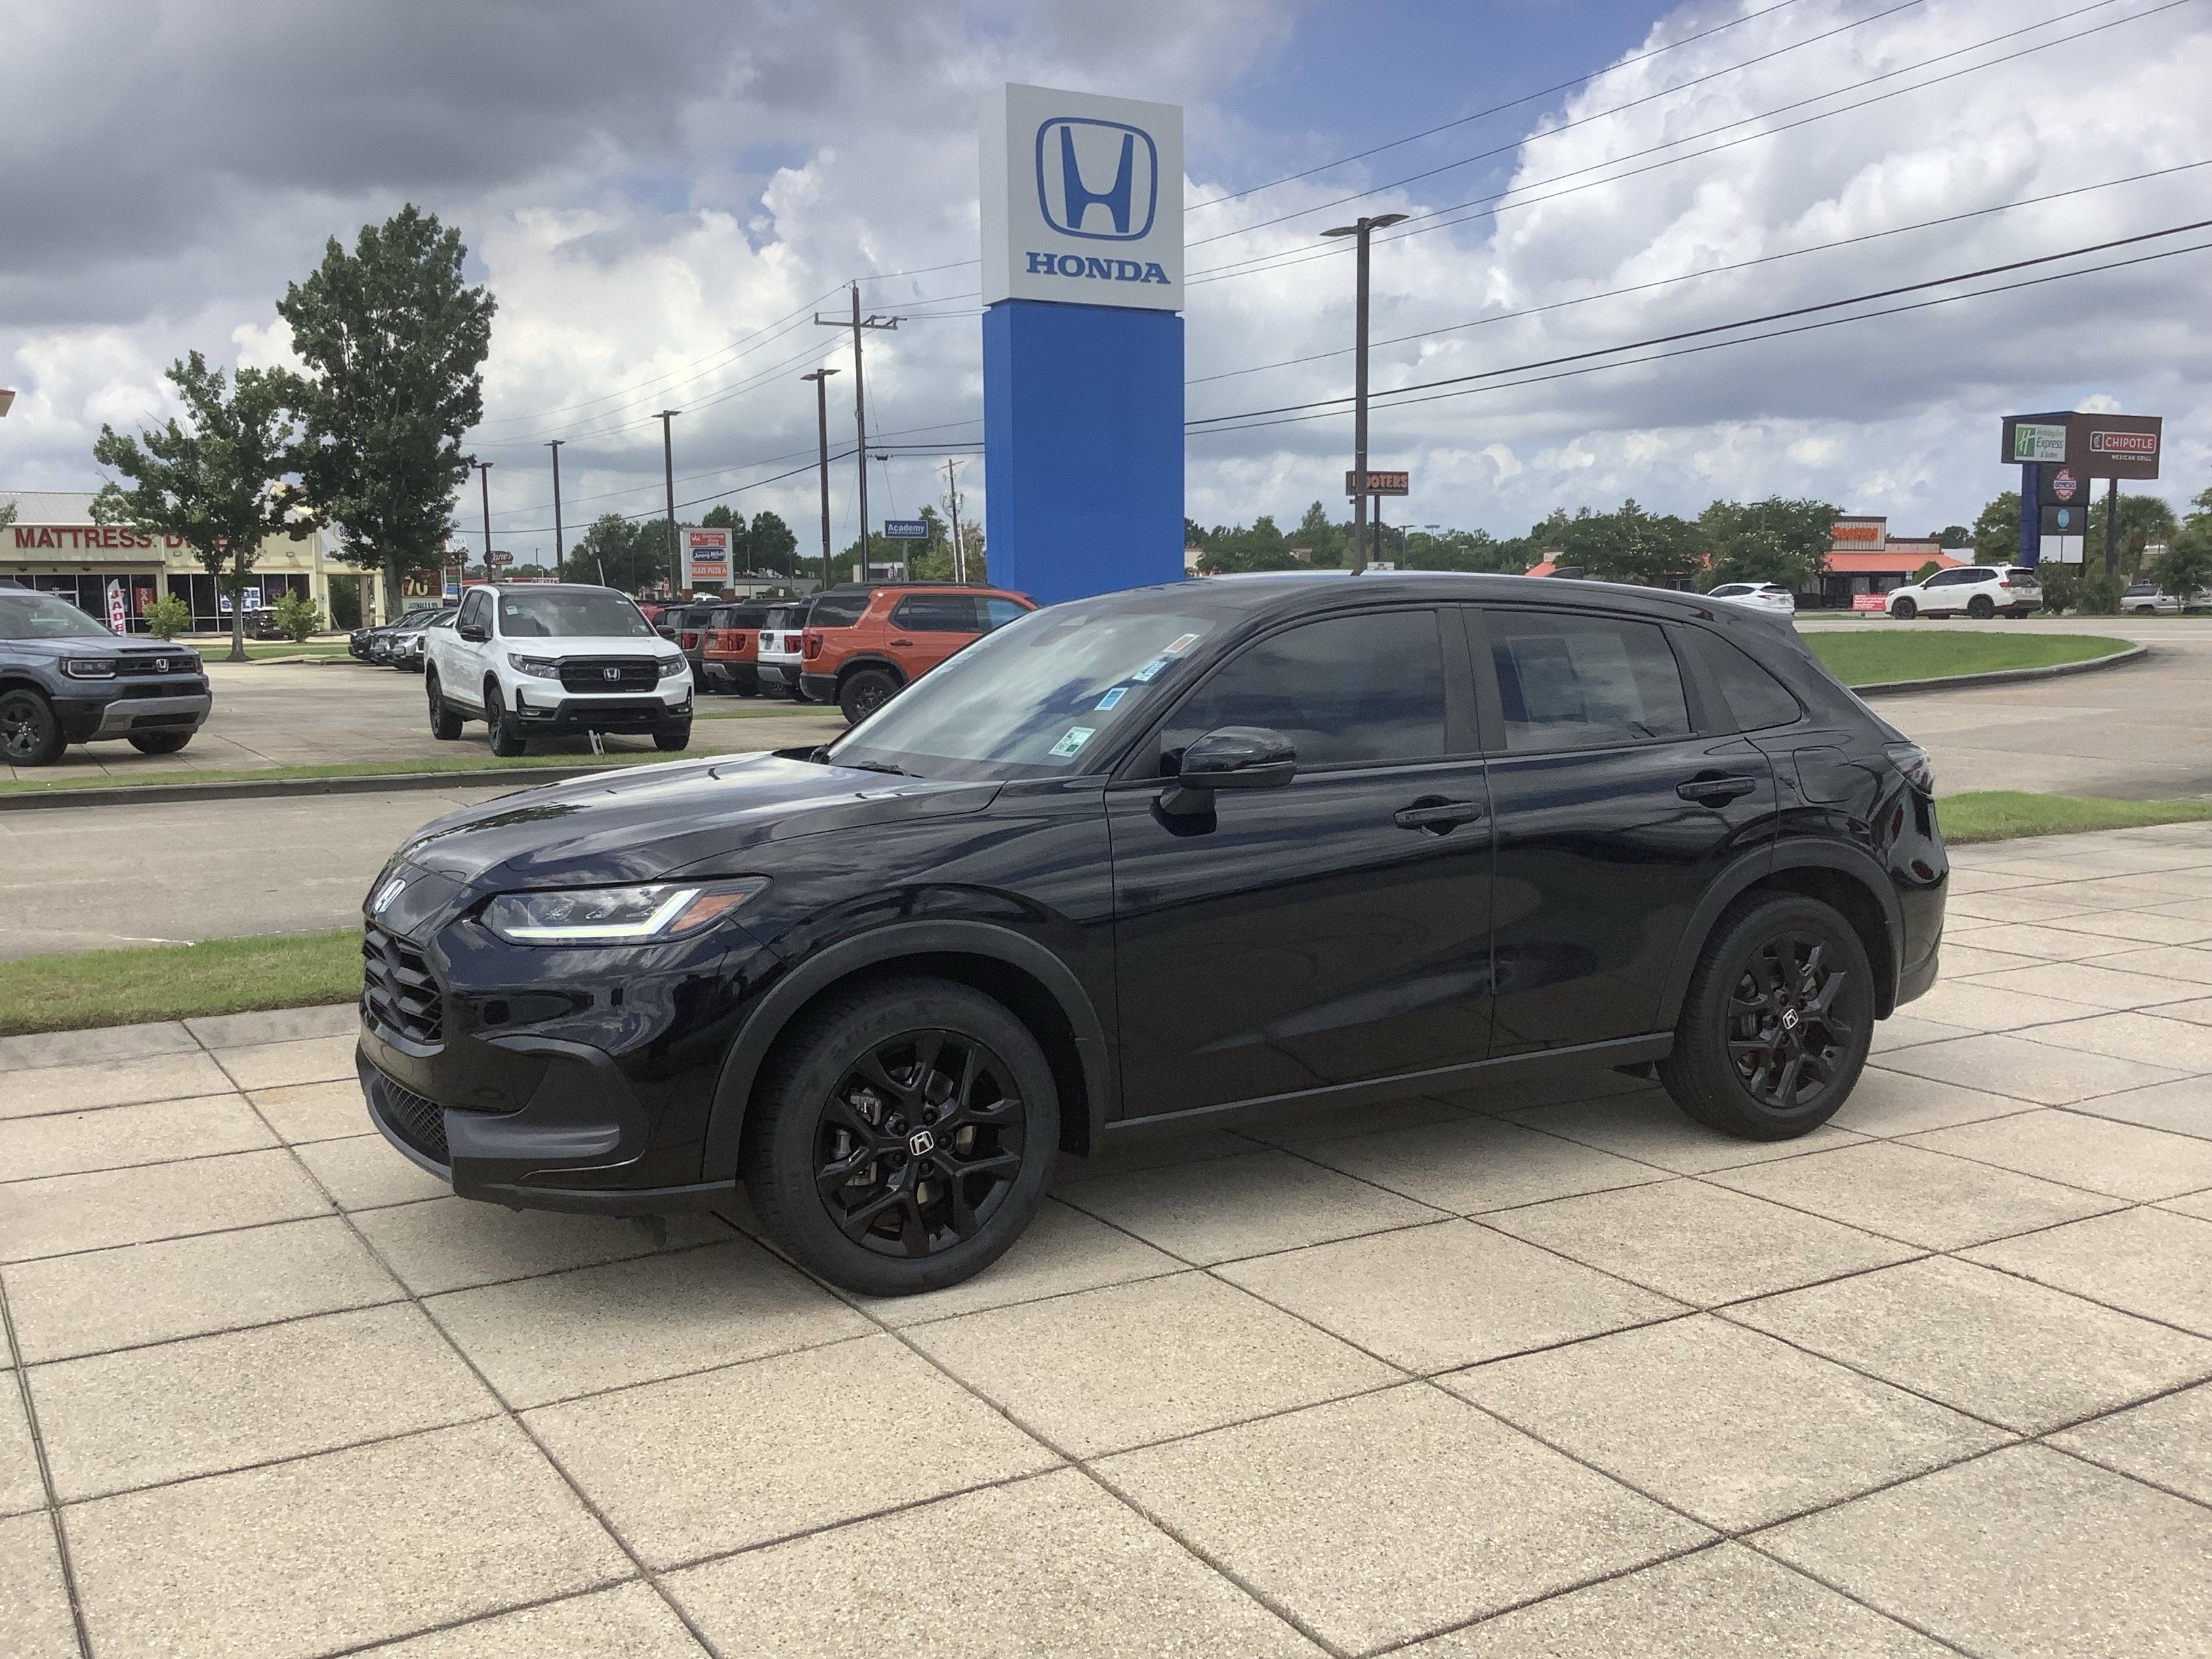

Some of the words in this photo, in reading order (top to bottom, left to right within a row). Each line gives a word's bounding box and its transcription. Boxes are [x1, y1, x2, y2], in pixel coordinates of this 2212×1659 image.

[1025, 251, 1171, 285] HONDA
[2036, 437, 2064, 450] Express
[2105, 437, 2153, 449] CHIPOTLE
[888, 524, 925, 533] Academy
[15, 528, 152, 549] MATTRESS
[221, 600, 260, 609] SLE
